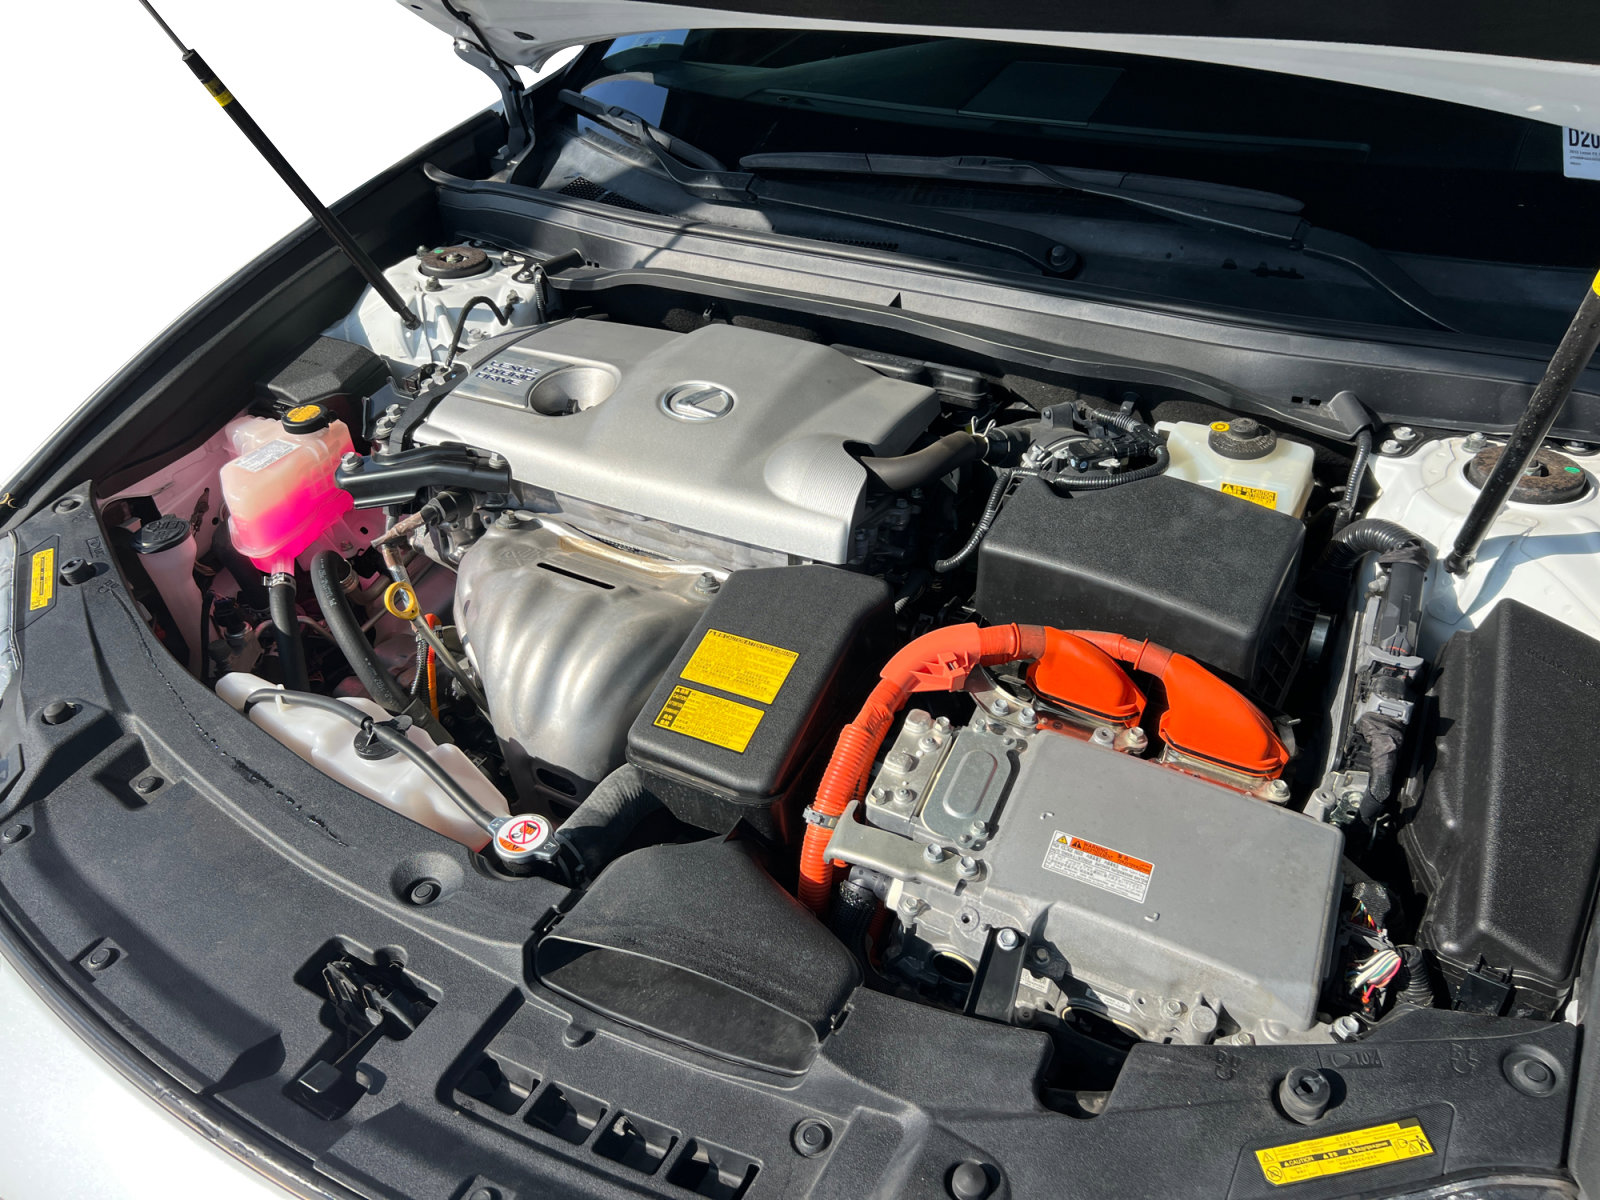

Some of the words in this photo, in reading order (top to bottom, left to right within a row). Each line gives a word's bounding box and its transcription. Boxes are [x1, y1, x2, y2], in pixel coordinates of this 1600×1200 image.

[482, 365, 537, 381] HYBRID
[490, 360, 541, 375] LEXUS
[475, 371, 523, 386] DRIVE
[1289, 1155, 1315, 1166] CAUTION
